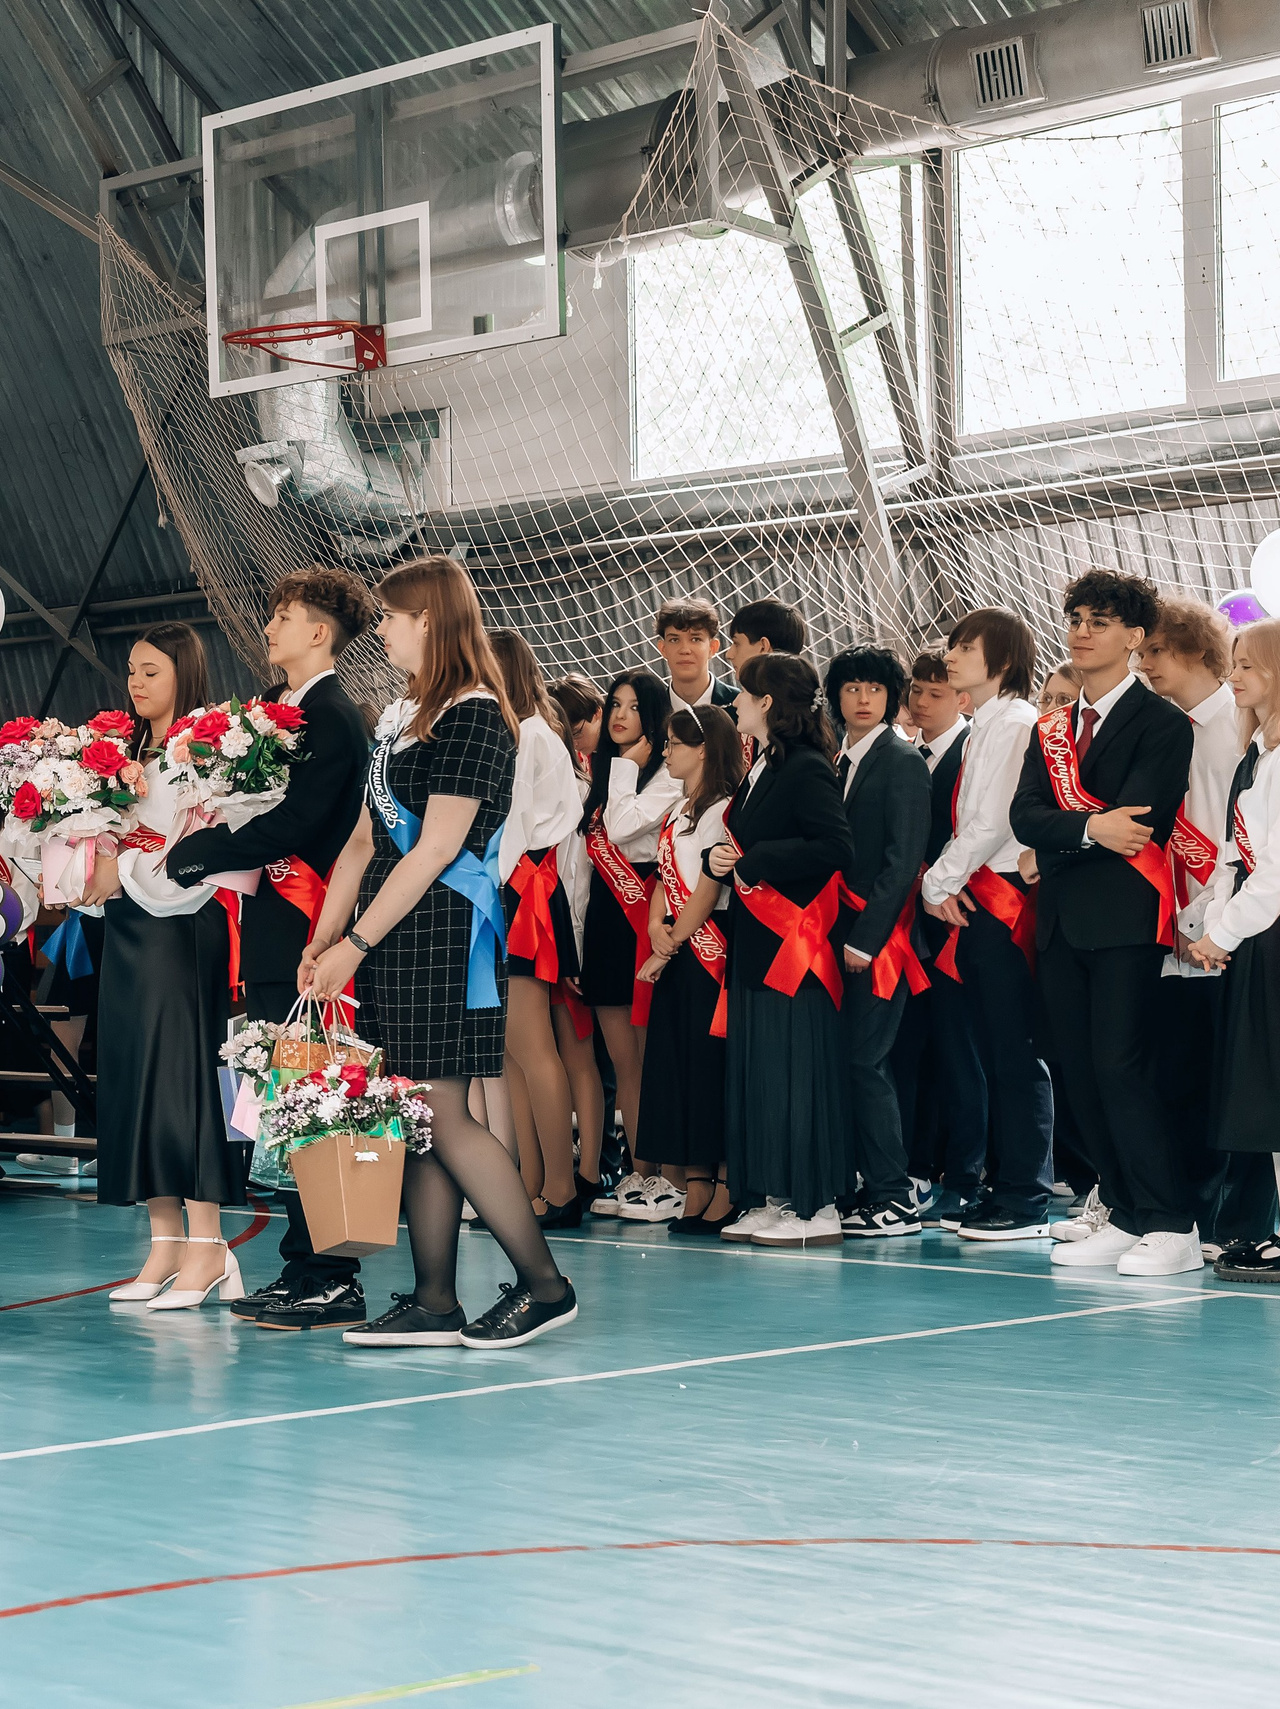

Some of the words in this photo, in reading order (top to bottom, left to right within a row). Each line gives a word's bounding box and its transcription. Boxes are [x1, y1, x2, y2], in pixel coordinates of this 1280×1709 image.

[379, 795, 407, 829] 2025
[1176, 839, 1217, 869] 2025
[619, 878, 647, 905] 2025
[693, 934, 727, 961] 2025
